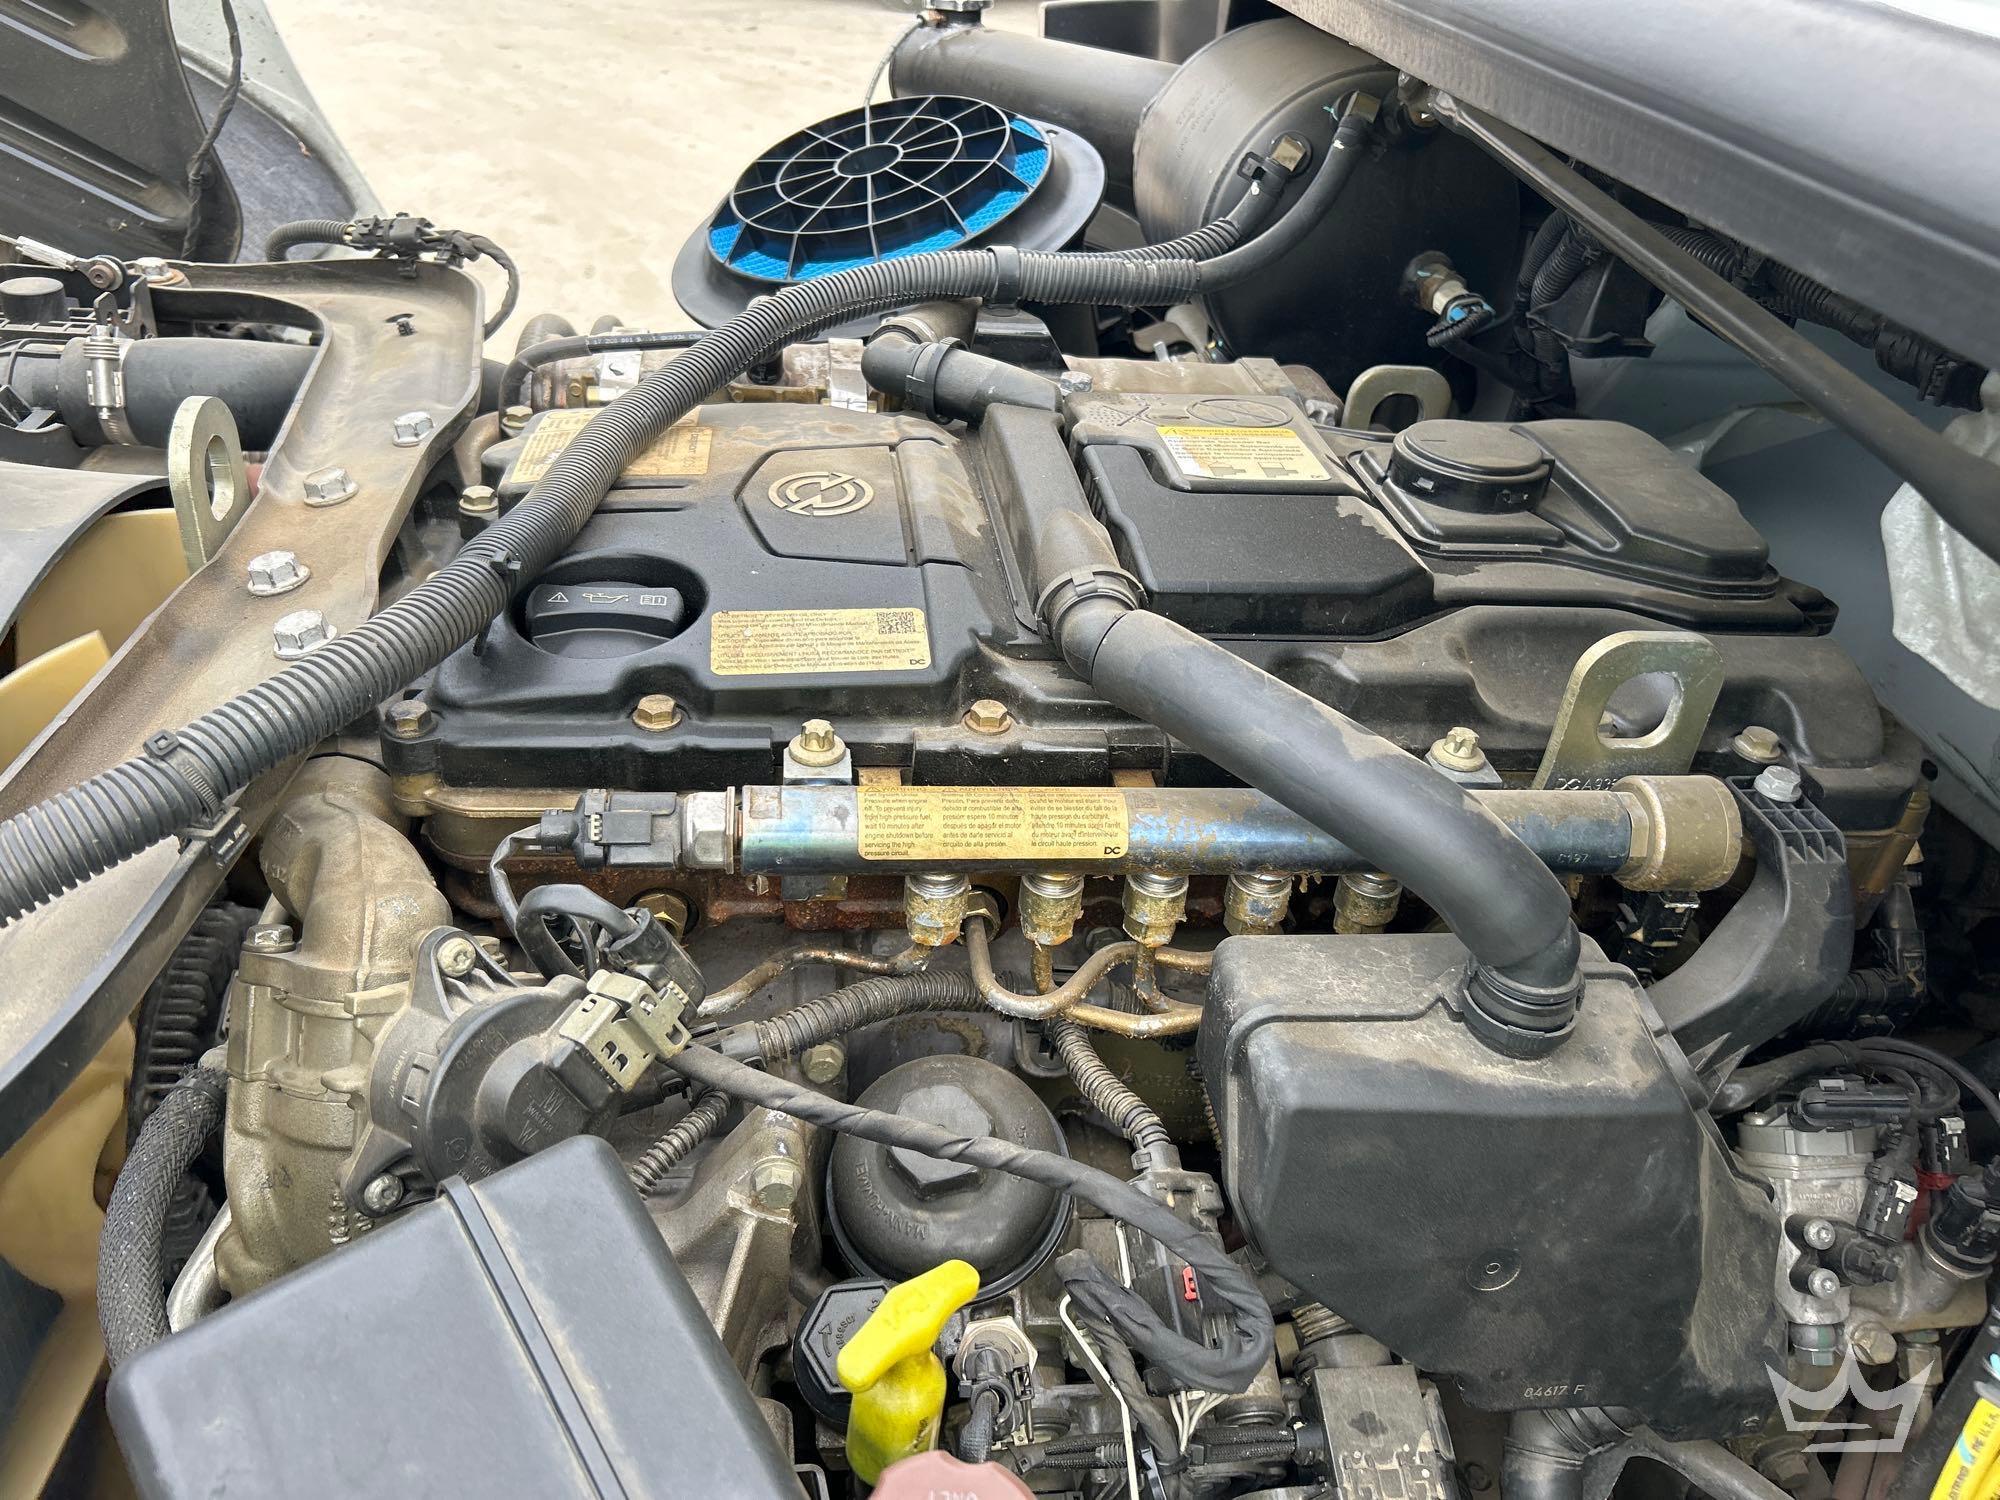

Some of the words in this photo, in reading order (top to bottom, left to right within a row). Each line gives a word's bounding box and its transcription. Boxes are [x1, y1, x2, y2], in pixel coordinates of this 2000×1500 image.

[864, 841, 890, 849] servicing
[892, 841, 901, 849] the
[1104, 846, 1121, 855] DC
[1573, 1384, 1585, 1395] F
